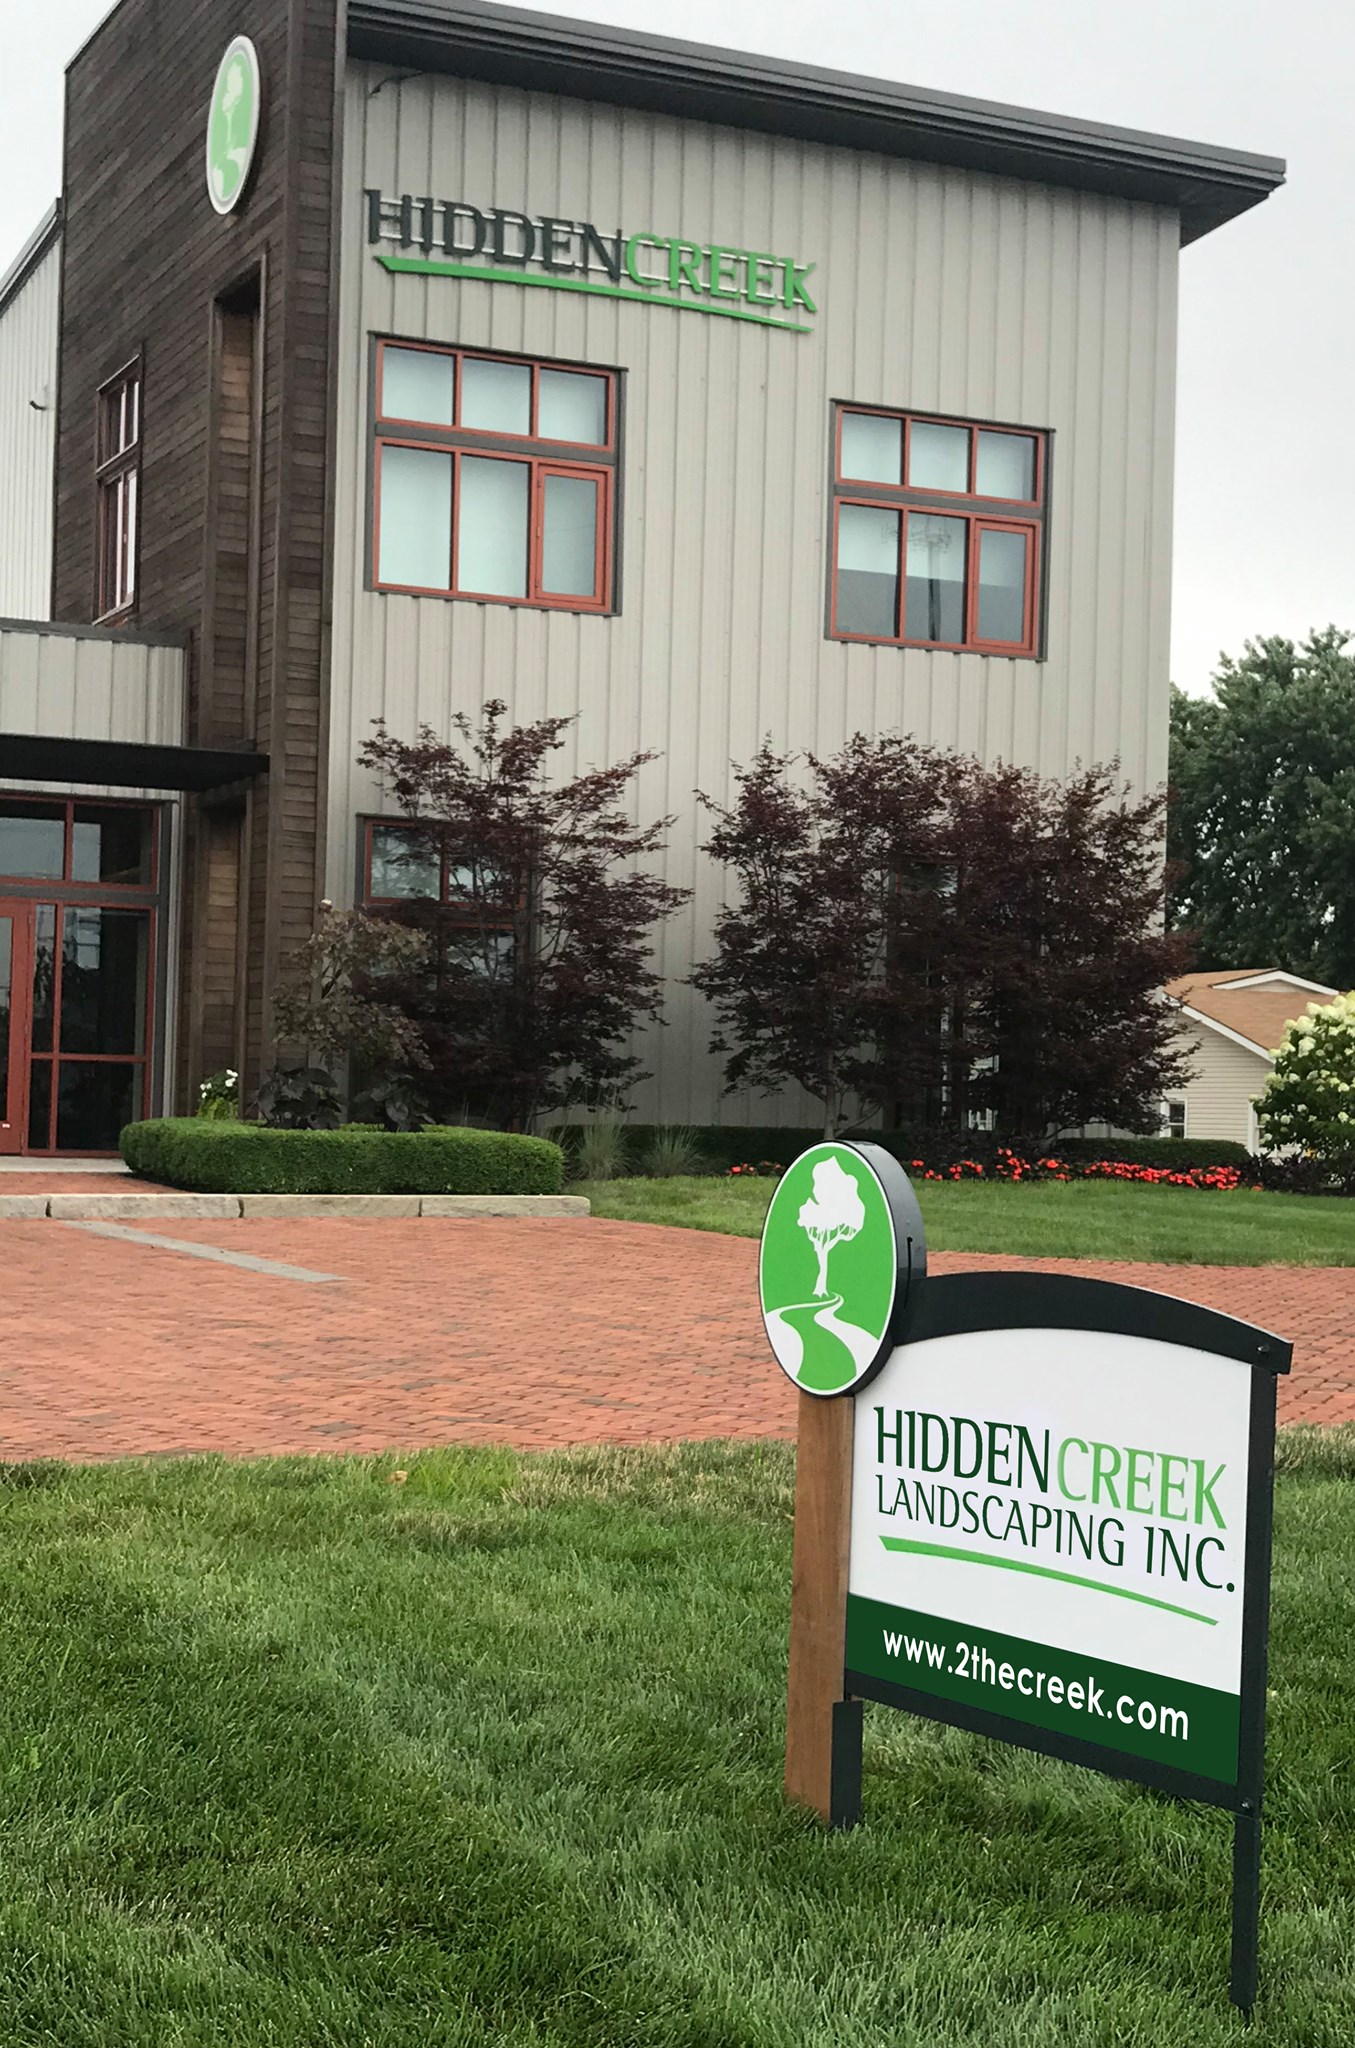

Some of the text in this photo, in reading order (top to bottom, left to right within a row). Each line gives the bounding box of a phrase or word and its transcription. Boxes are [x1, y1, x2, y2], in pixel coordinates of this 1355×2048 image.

[875, 1474, 1236, 1594] LANDSCAPING INC.
[882, 1629, 1190, 1741] www.2thecreek.com
